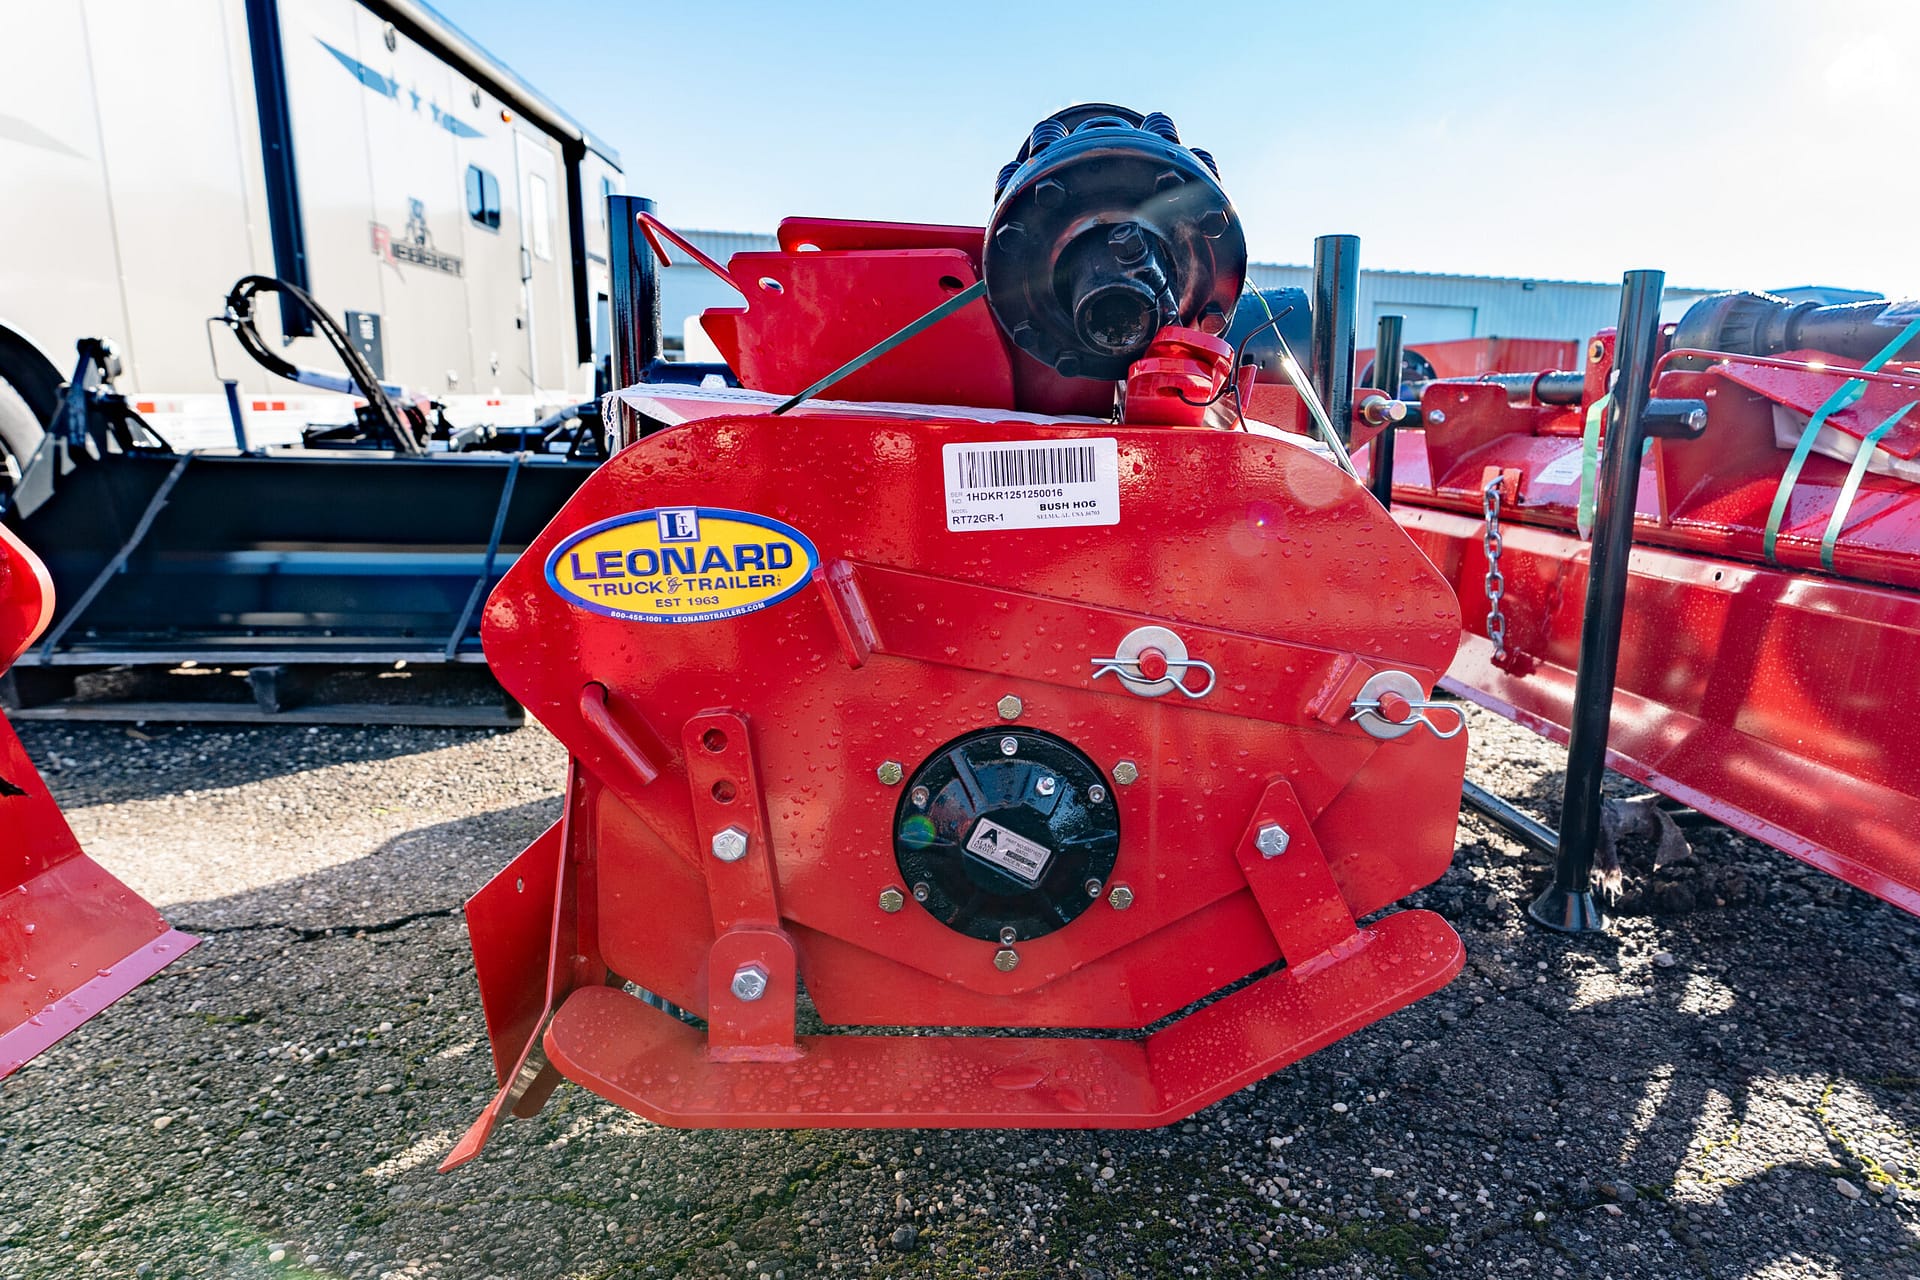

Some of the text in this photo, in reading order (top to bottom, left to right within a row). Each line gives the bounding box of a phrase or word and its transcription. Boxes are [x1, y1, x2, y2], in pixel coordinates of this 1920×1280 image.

[966, 489, 1063, 502] 1HDKR1251250016
[1040, 500, 1096, 511] BUSH HOG
[952, 513, 1004, 525] RT72GR-1
[570, 542, 792, 580] LEONARD
[588, 581, 663, 596] TRUCK
[684, 574, 775, 592] TRAILER
[655, 596, 719, 607] EST 1963
[610, 602, 766, 623] 800-455-1001 LEONARDTRAILERS.COM
[973, 843, 995, 856] GROUP
[976, 840, 997, 851] ALAMO
